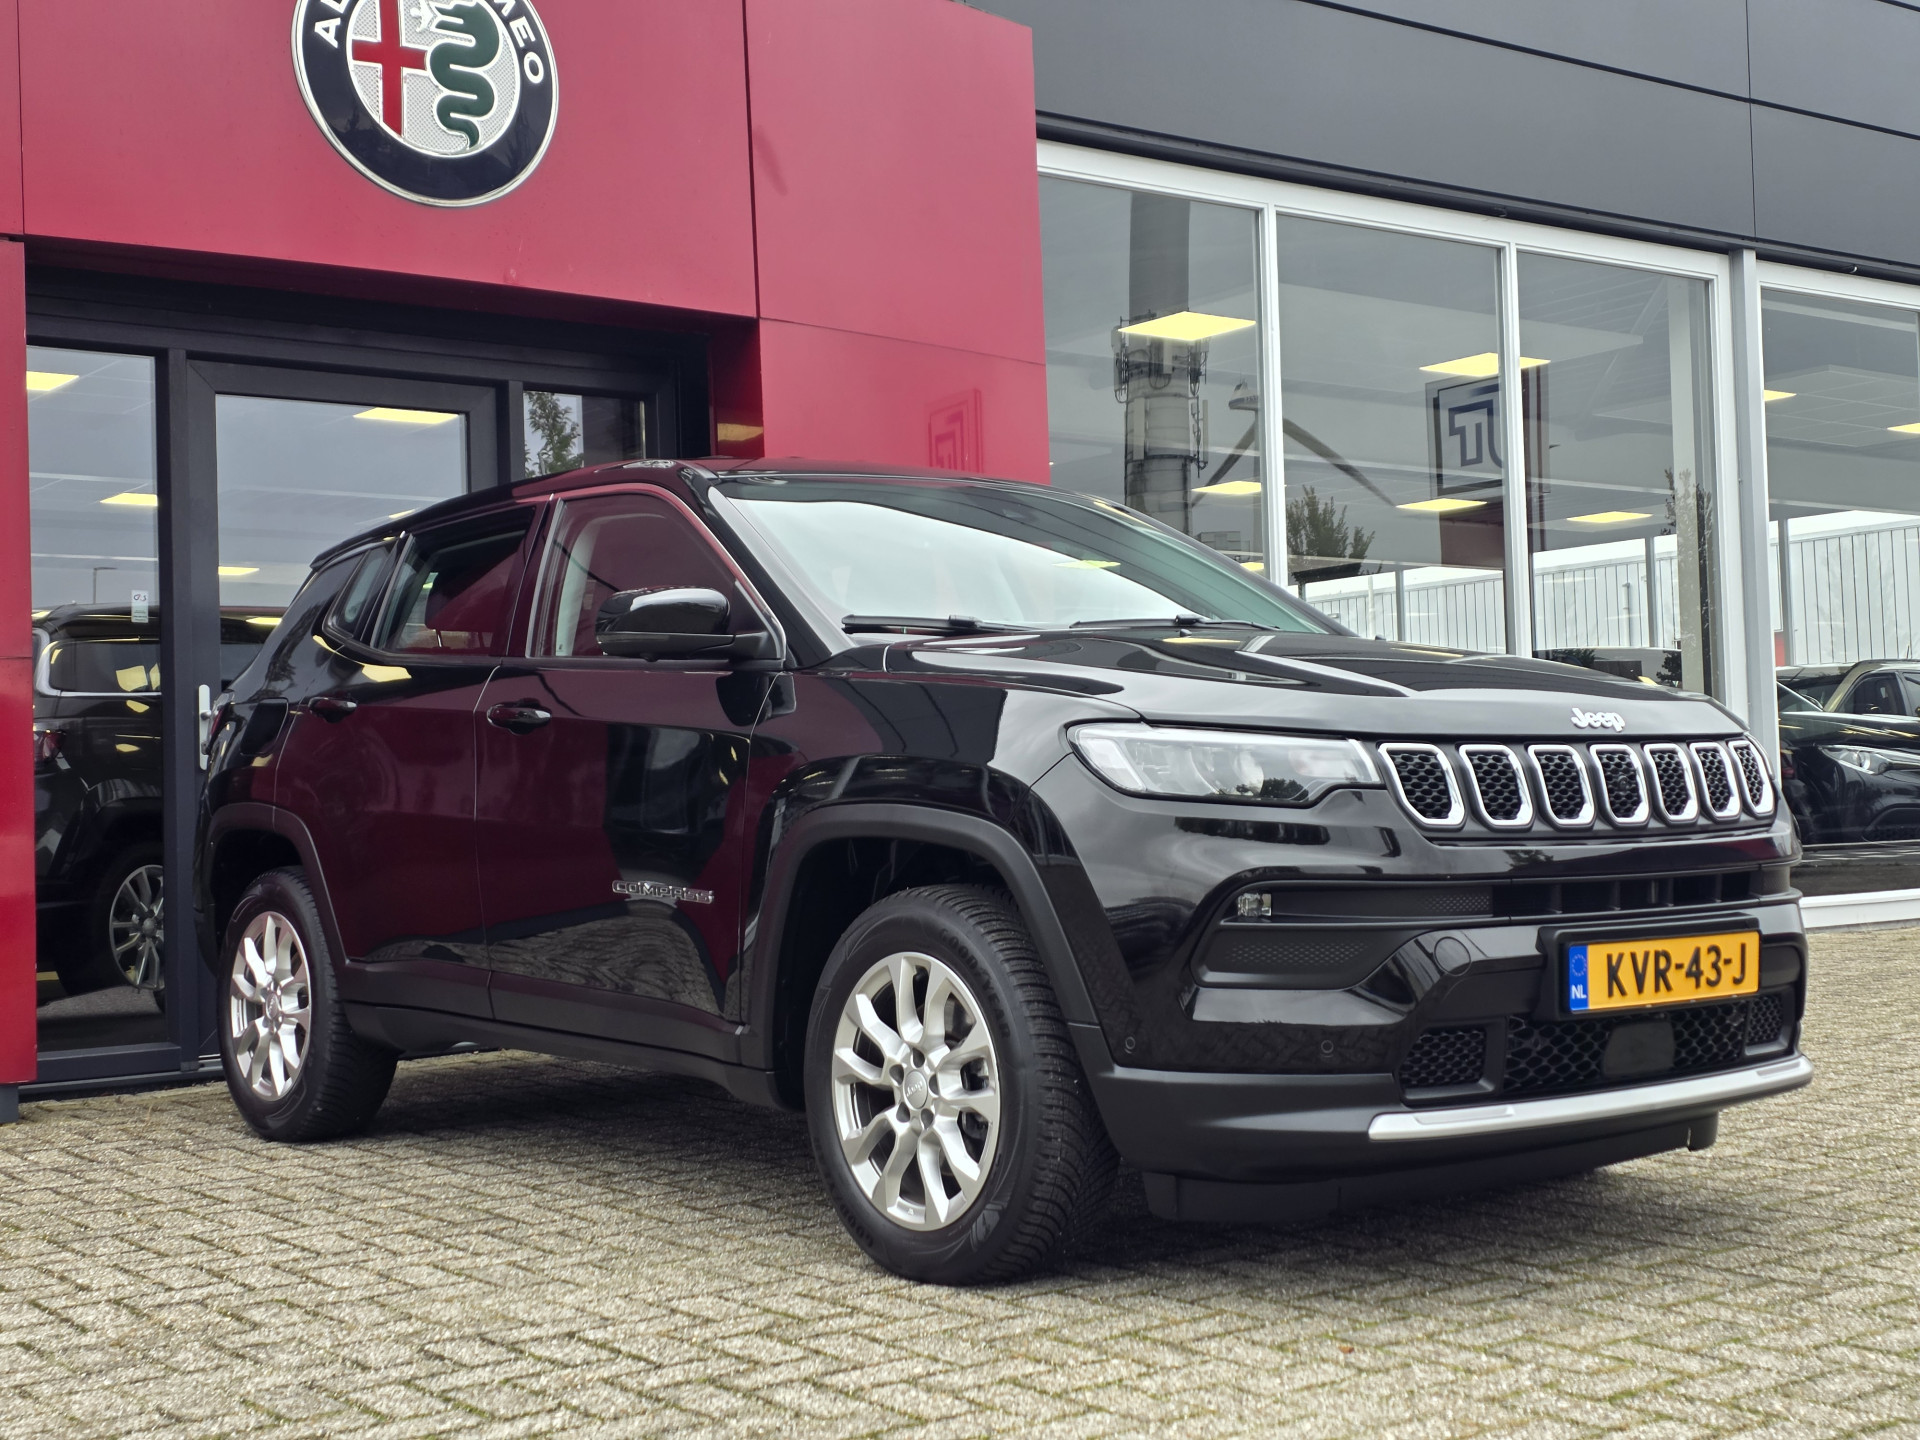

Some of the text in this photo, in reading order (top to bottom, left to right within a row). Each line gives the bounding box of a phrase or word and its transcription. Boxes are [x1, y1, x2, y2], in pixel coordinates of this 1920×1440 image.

[1570, 707, 1626, 732] Jeep
[1606, 943, 1747, 998] KVR-43-J
[1571, 985, 1588, 1000] NL
